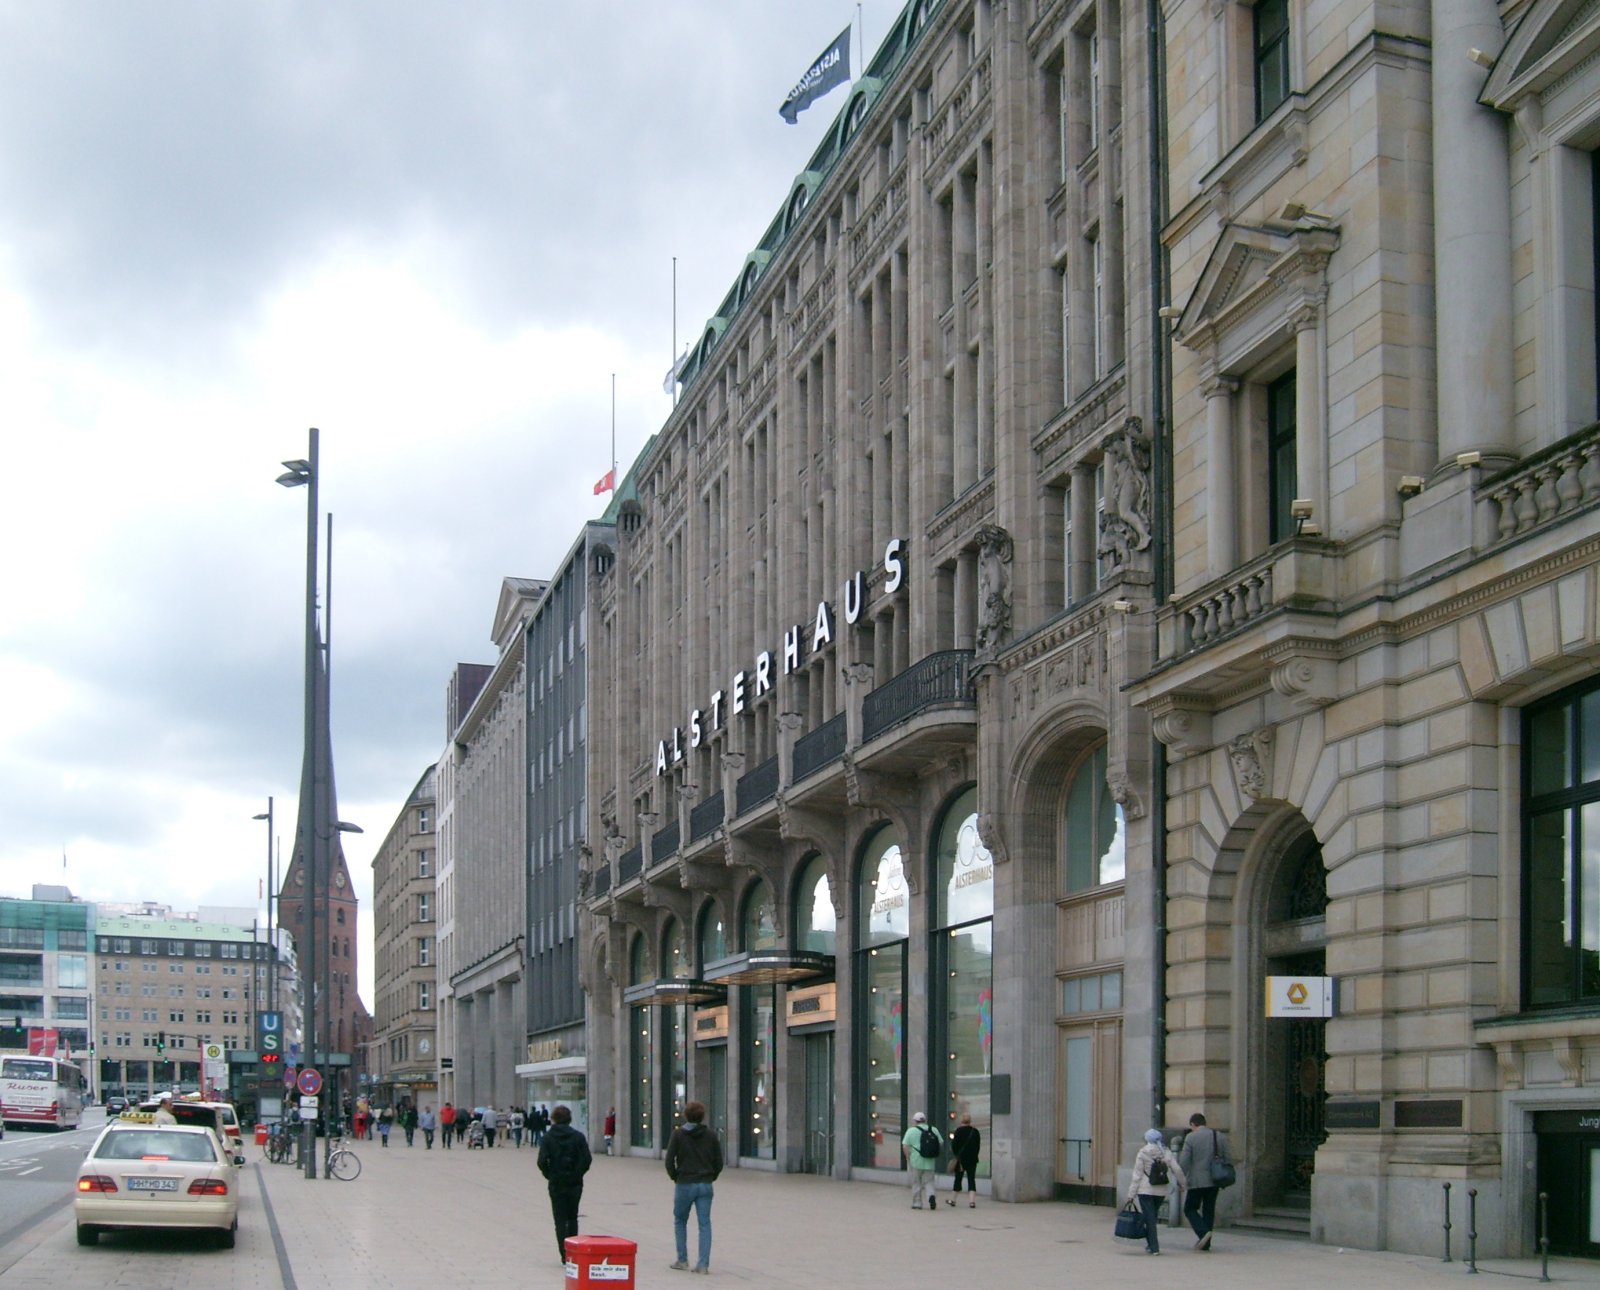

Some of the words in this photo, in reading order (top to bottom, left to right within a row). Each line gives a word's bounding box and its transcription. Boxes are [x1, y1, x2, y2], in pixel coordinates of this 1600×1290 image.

[656, 538, 904, 777] ALSTERHAUS
[264, 1014, 278, 1031] U
[264, 1034, 278, 1050] S
